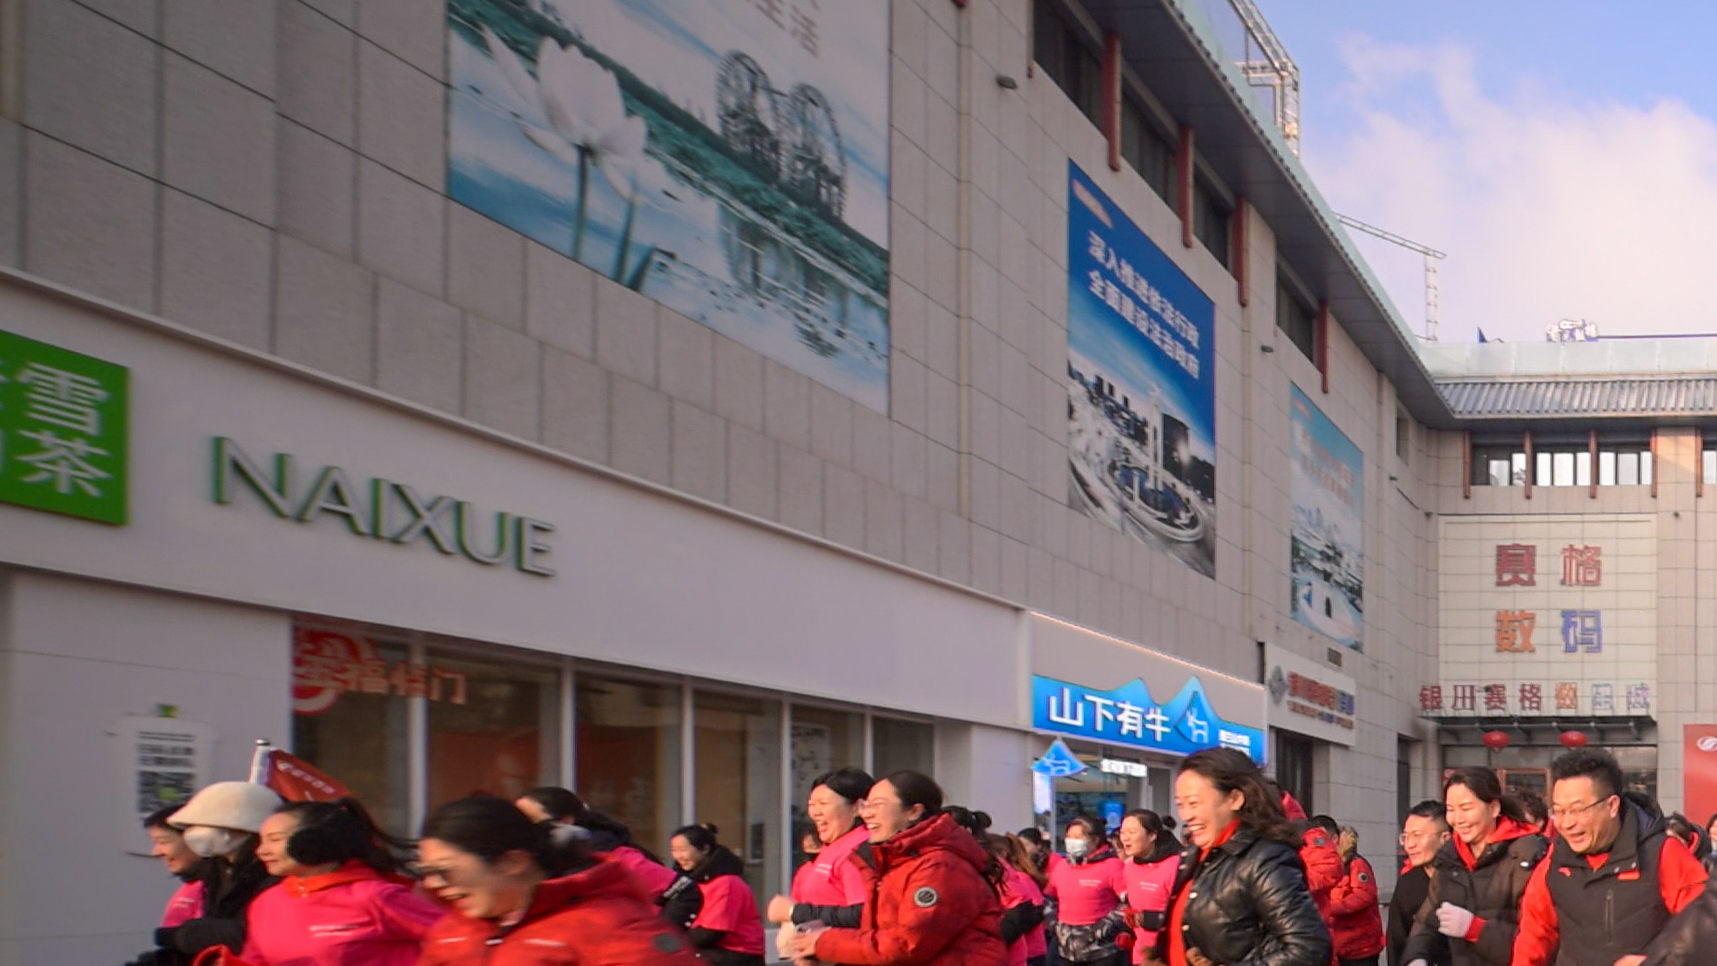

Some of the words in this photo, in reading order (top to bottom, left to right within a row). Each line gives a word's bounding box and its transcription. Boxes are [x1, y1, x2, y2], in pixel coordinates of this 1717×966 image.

[0, 361, 111, 436] 雪
[0, 428, 112, 498] 茶
[212, 435, 556, 577] NAIXUE
[1495, 543, 1603, 587] 赛格
[1495, 609, 1603, 654] 数码
[1049, 687, 1171, 742] 山下有牛
[1419, 682, 1651, 712] 银川赛格数码城
